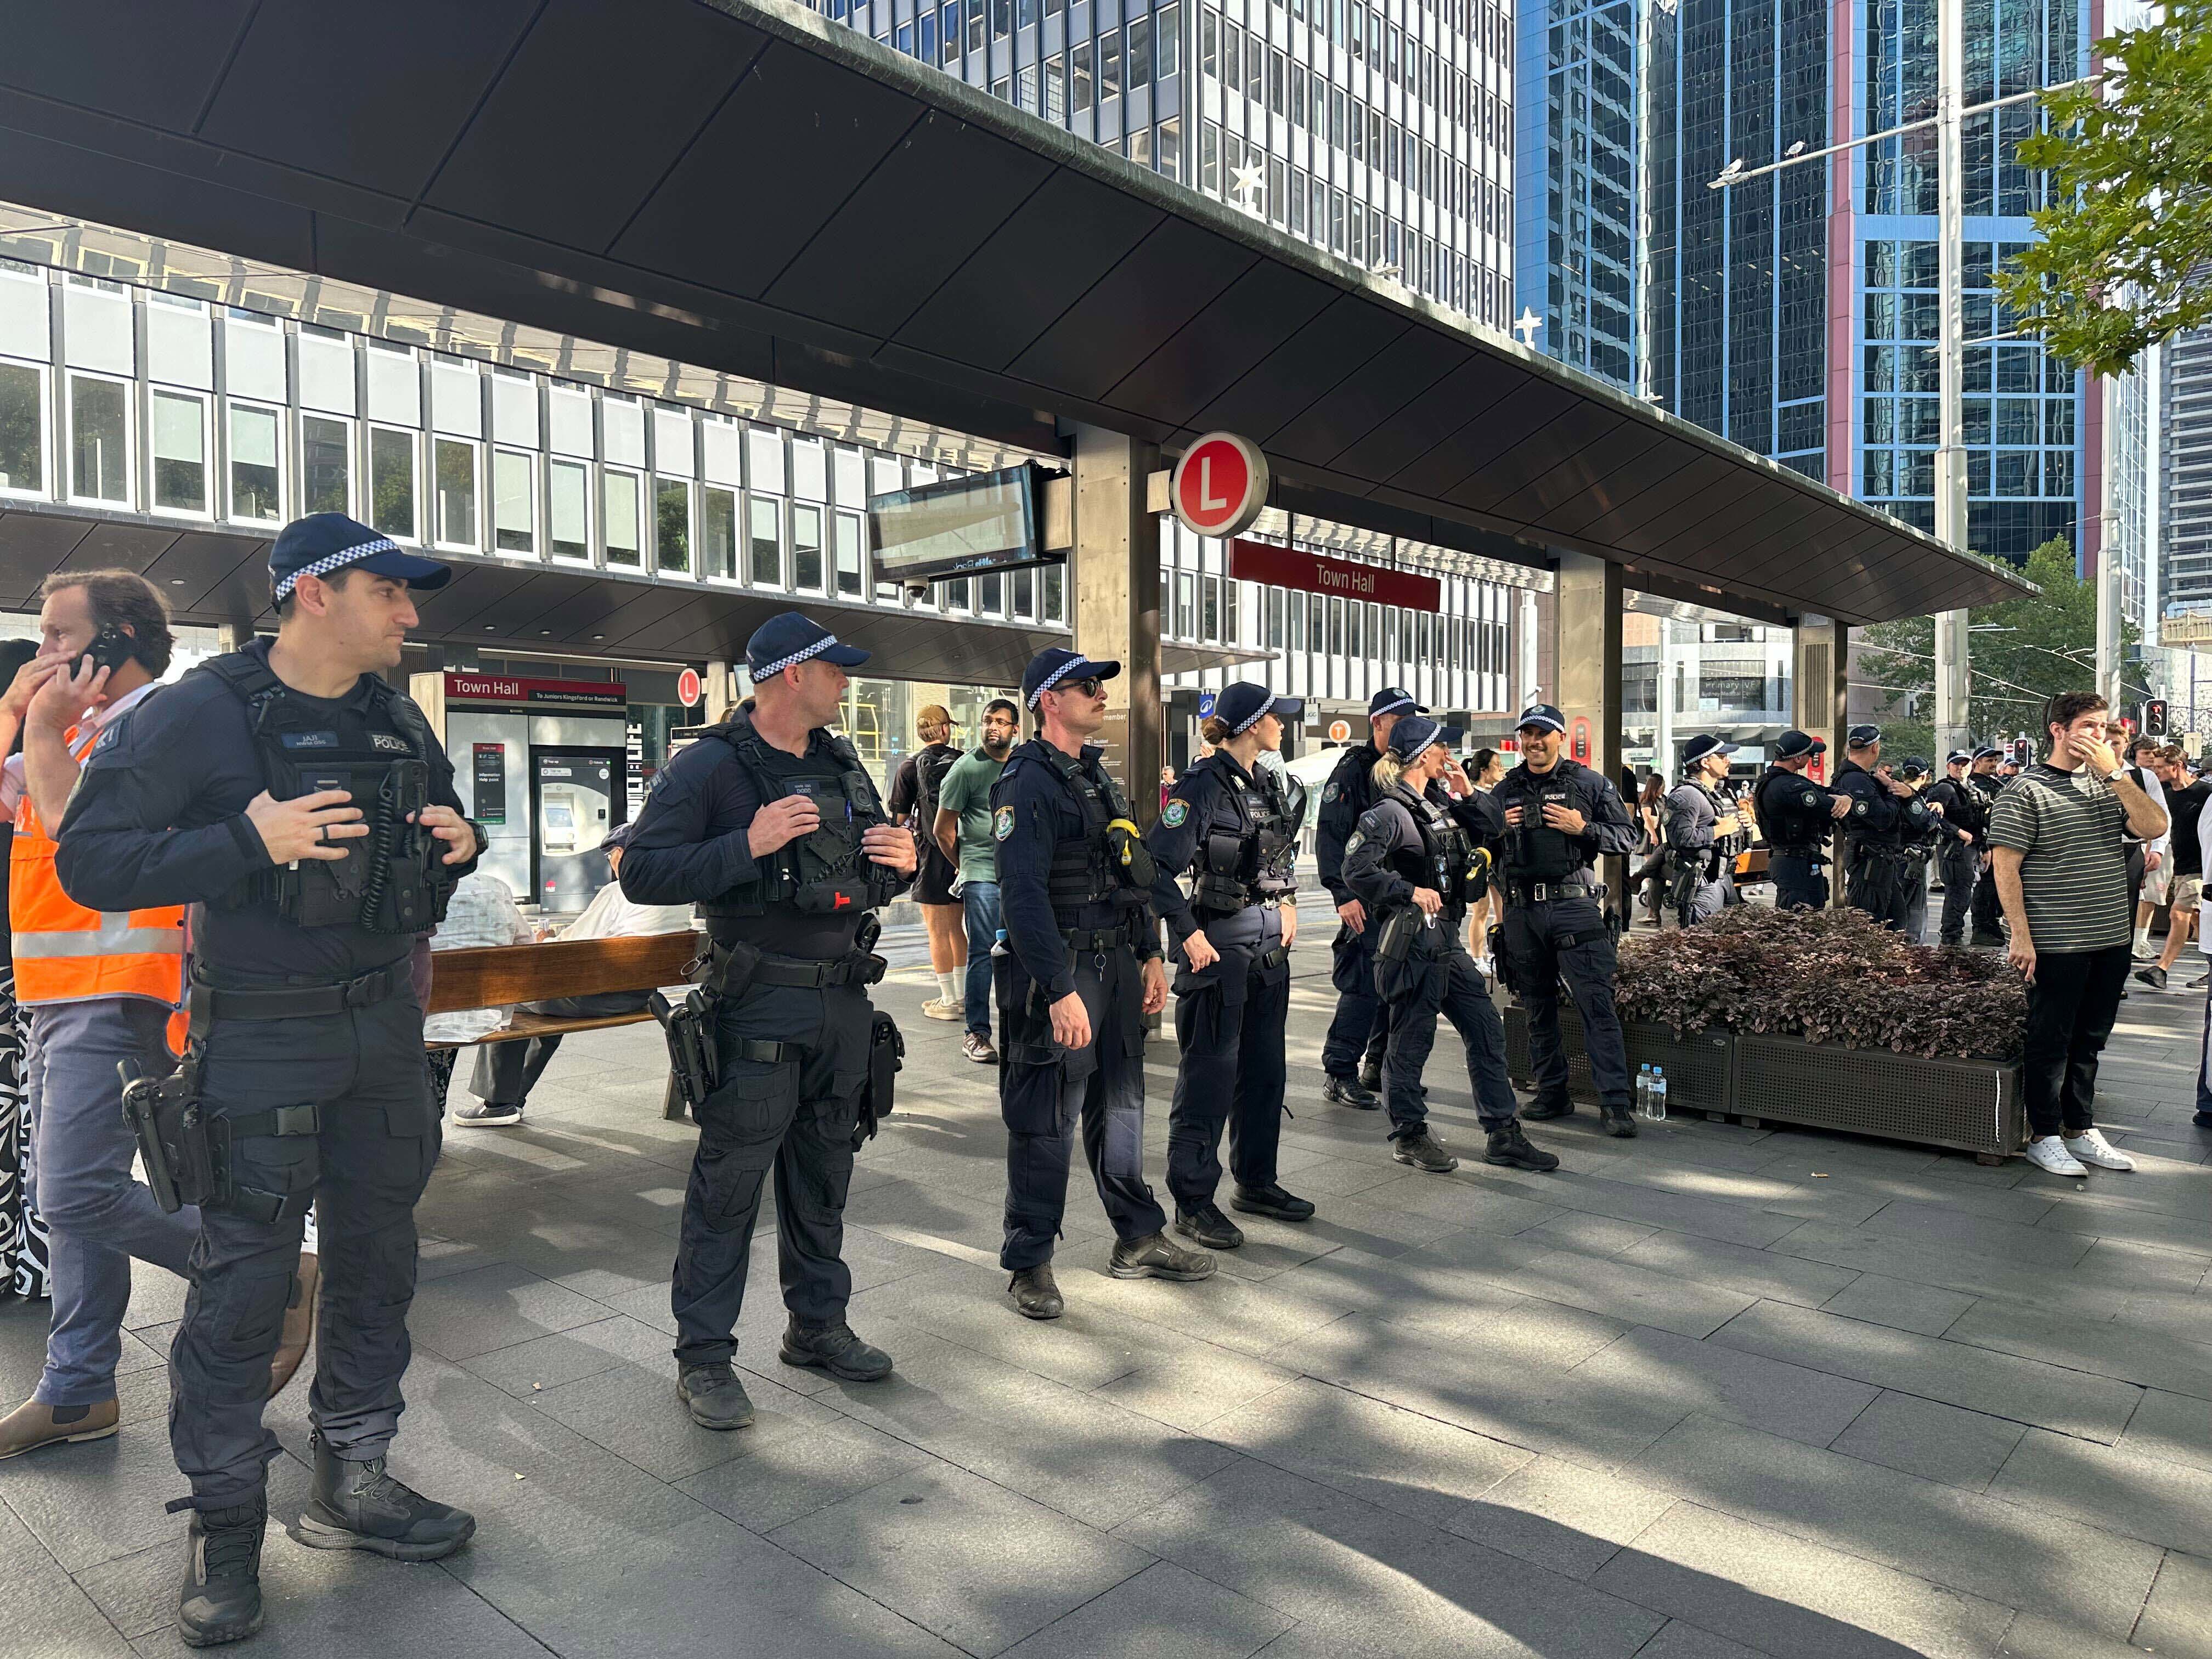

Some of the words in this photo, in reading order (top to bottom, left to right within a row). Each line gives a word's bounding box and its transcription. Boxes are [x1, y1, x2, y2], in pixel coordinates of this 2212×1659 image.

[1200, 456, 1227, 511] L
[1316, 563, 1348, 590] Town
[1352, 570, 1375, 594] Hall
[454, 679, 490, 694] Town
[494, 681, 518, 696] Hall
[685, 677, 693, 698] L
[1334, 726, 1344, 738] T
